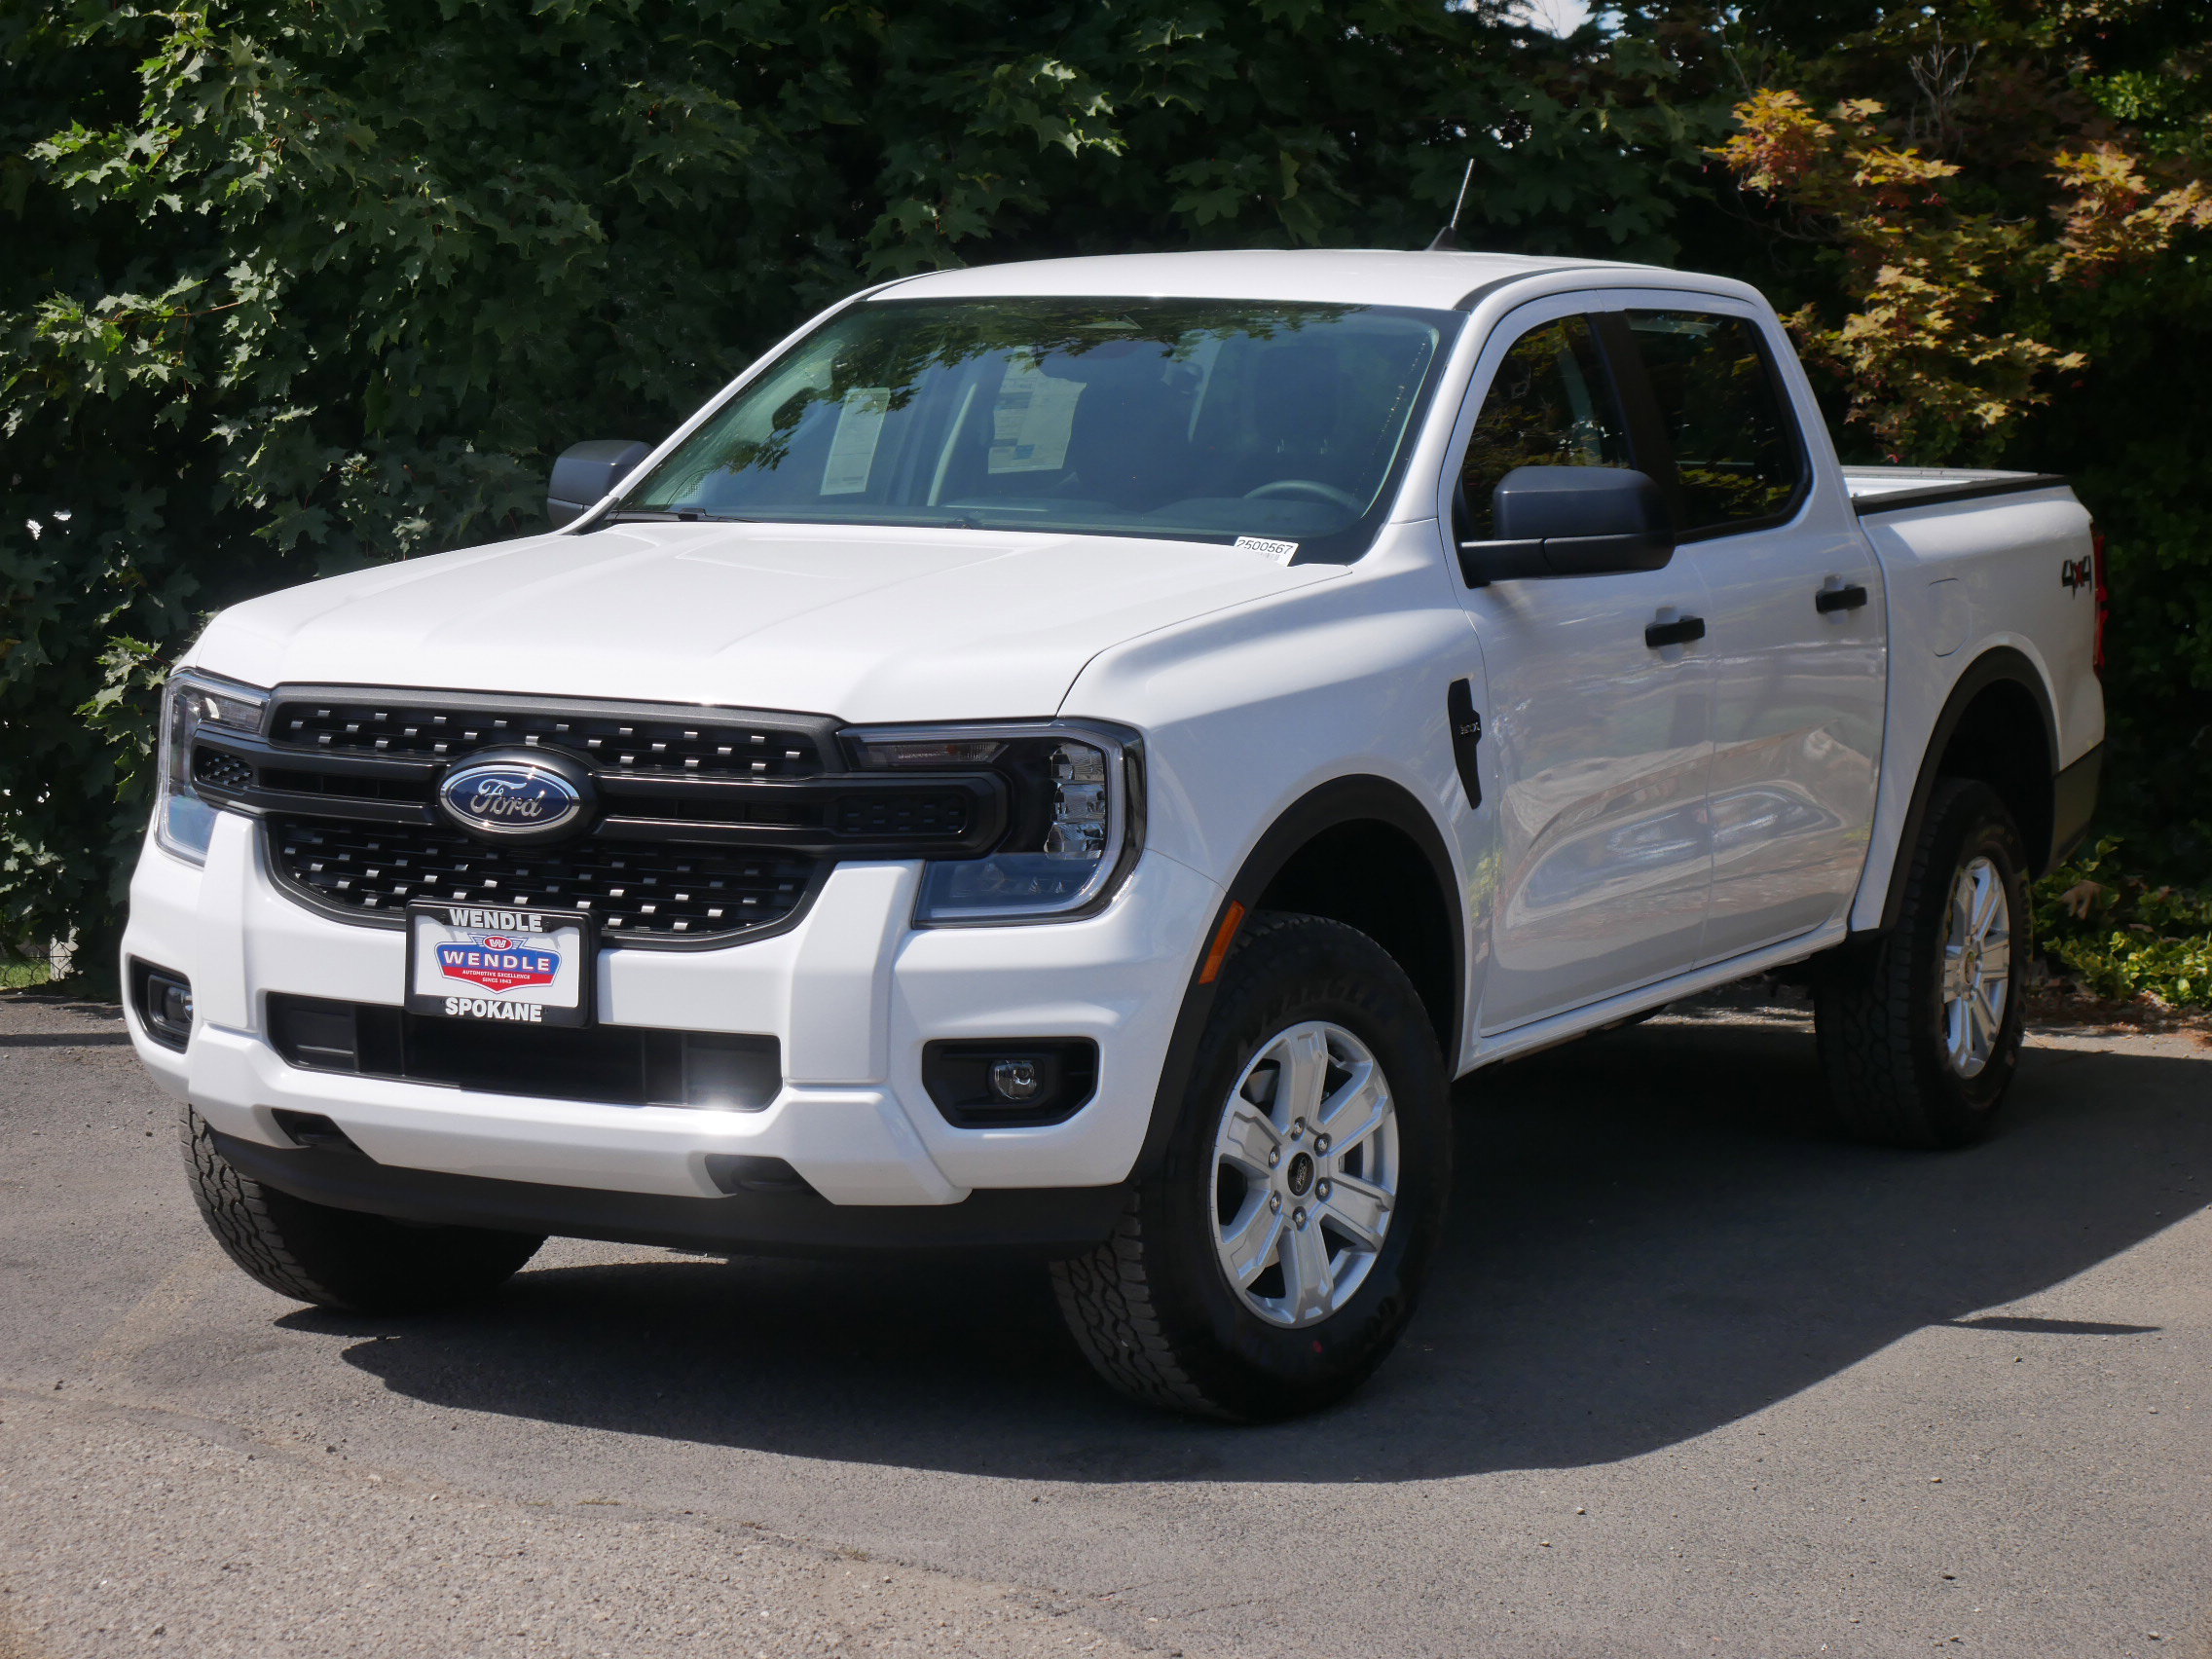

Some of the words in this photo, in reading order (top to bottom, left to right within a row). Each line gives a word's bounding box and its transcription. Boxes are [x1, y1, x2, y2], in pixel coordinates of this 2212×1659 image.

[1236, 539, 1293, 554] 2500567
[469, 778, 545, 818] Ford
[449, 908, 543, 933] WENDLE
[443, 950, 550, 972] WENDLE
[445, 997, 542, 1022] SPOKANE
